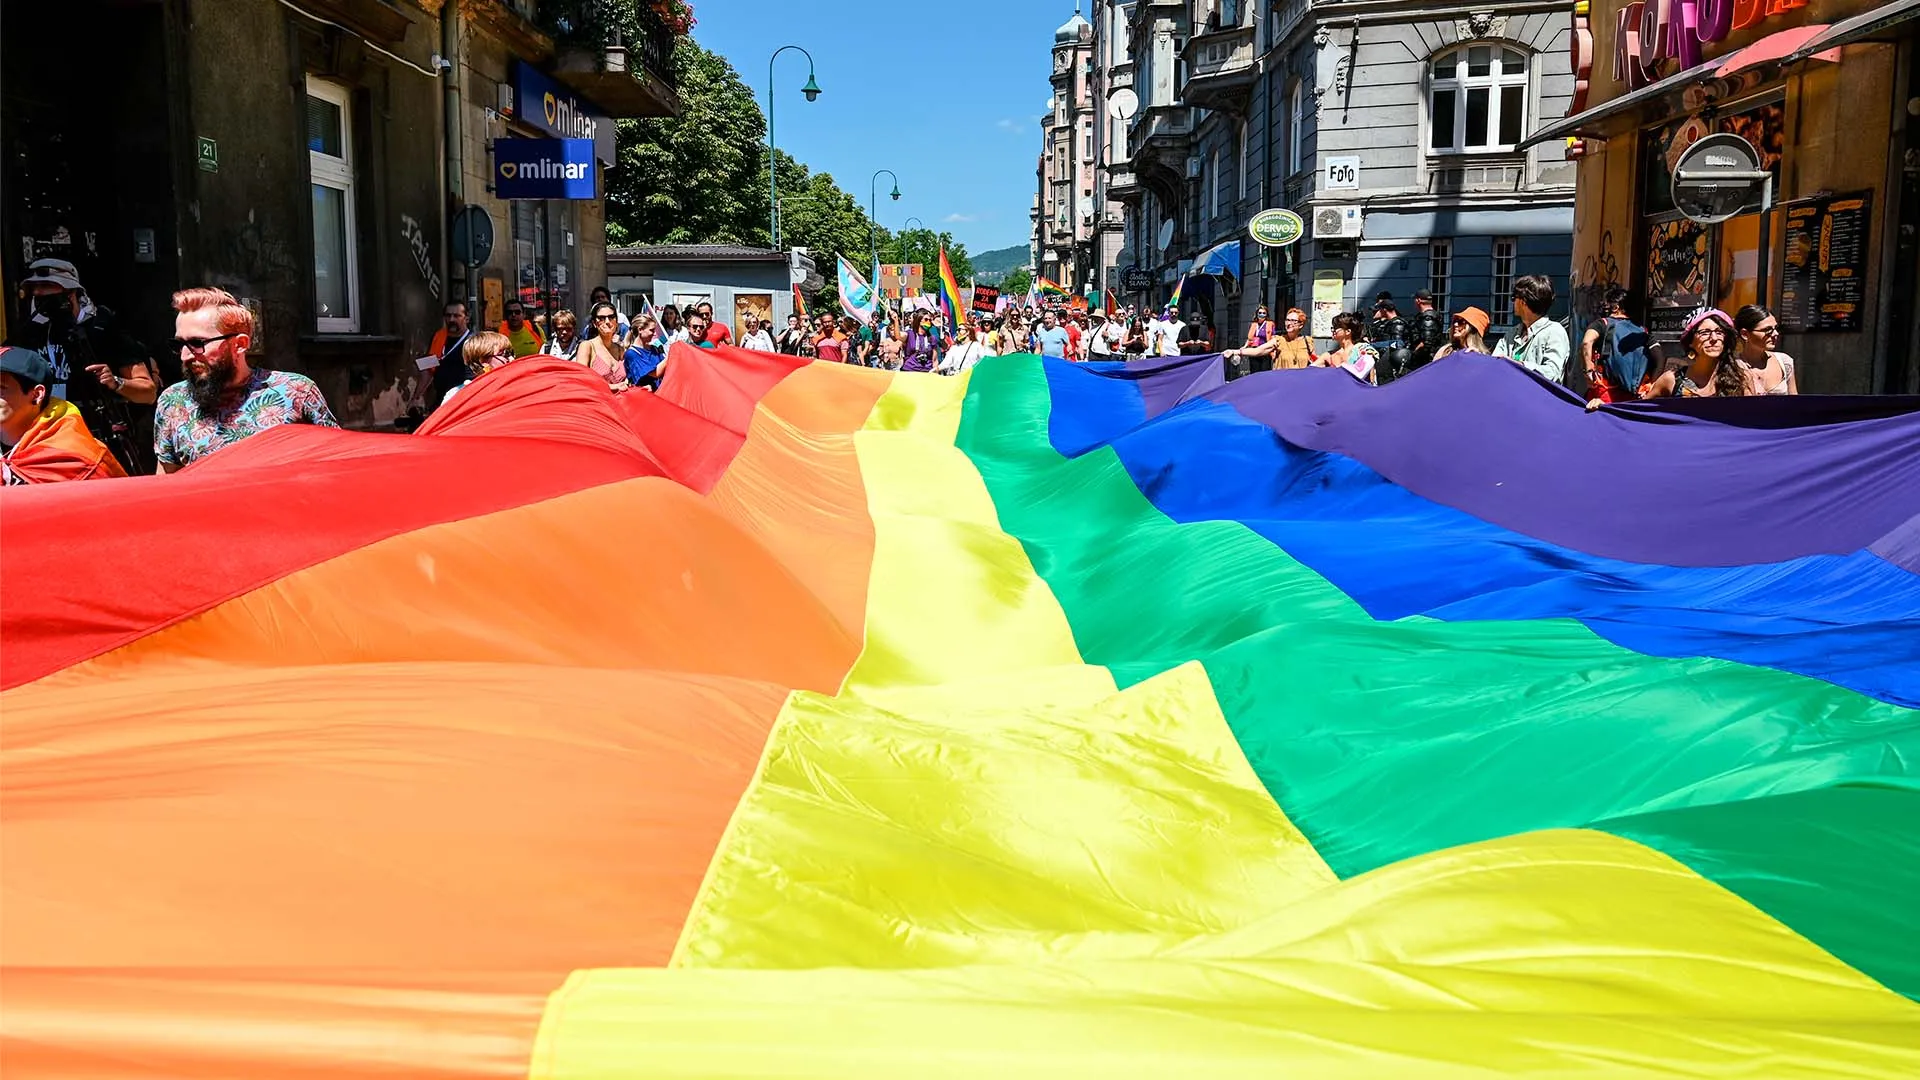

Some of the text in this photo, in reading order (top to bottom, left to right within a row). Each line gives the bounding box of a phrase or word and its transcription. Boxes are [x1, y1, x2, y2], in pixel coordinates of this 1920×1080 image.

[557, 97, 597, 139] mlinar
[203, 143, 213, 157] 21
[519, 158, 588, 179] mlinar
[1329, 164, 1355, 183] FOTO
[898, 275, 907, 287] U
